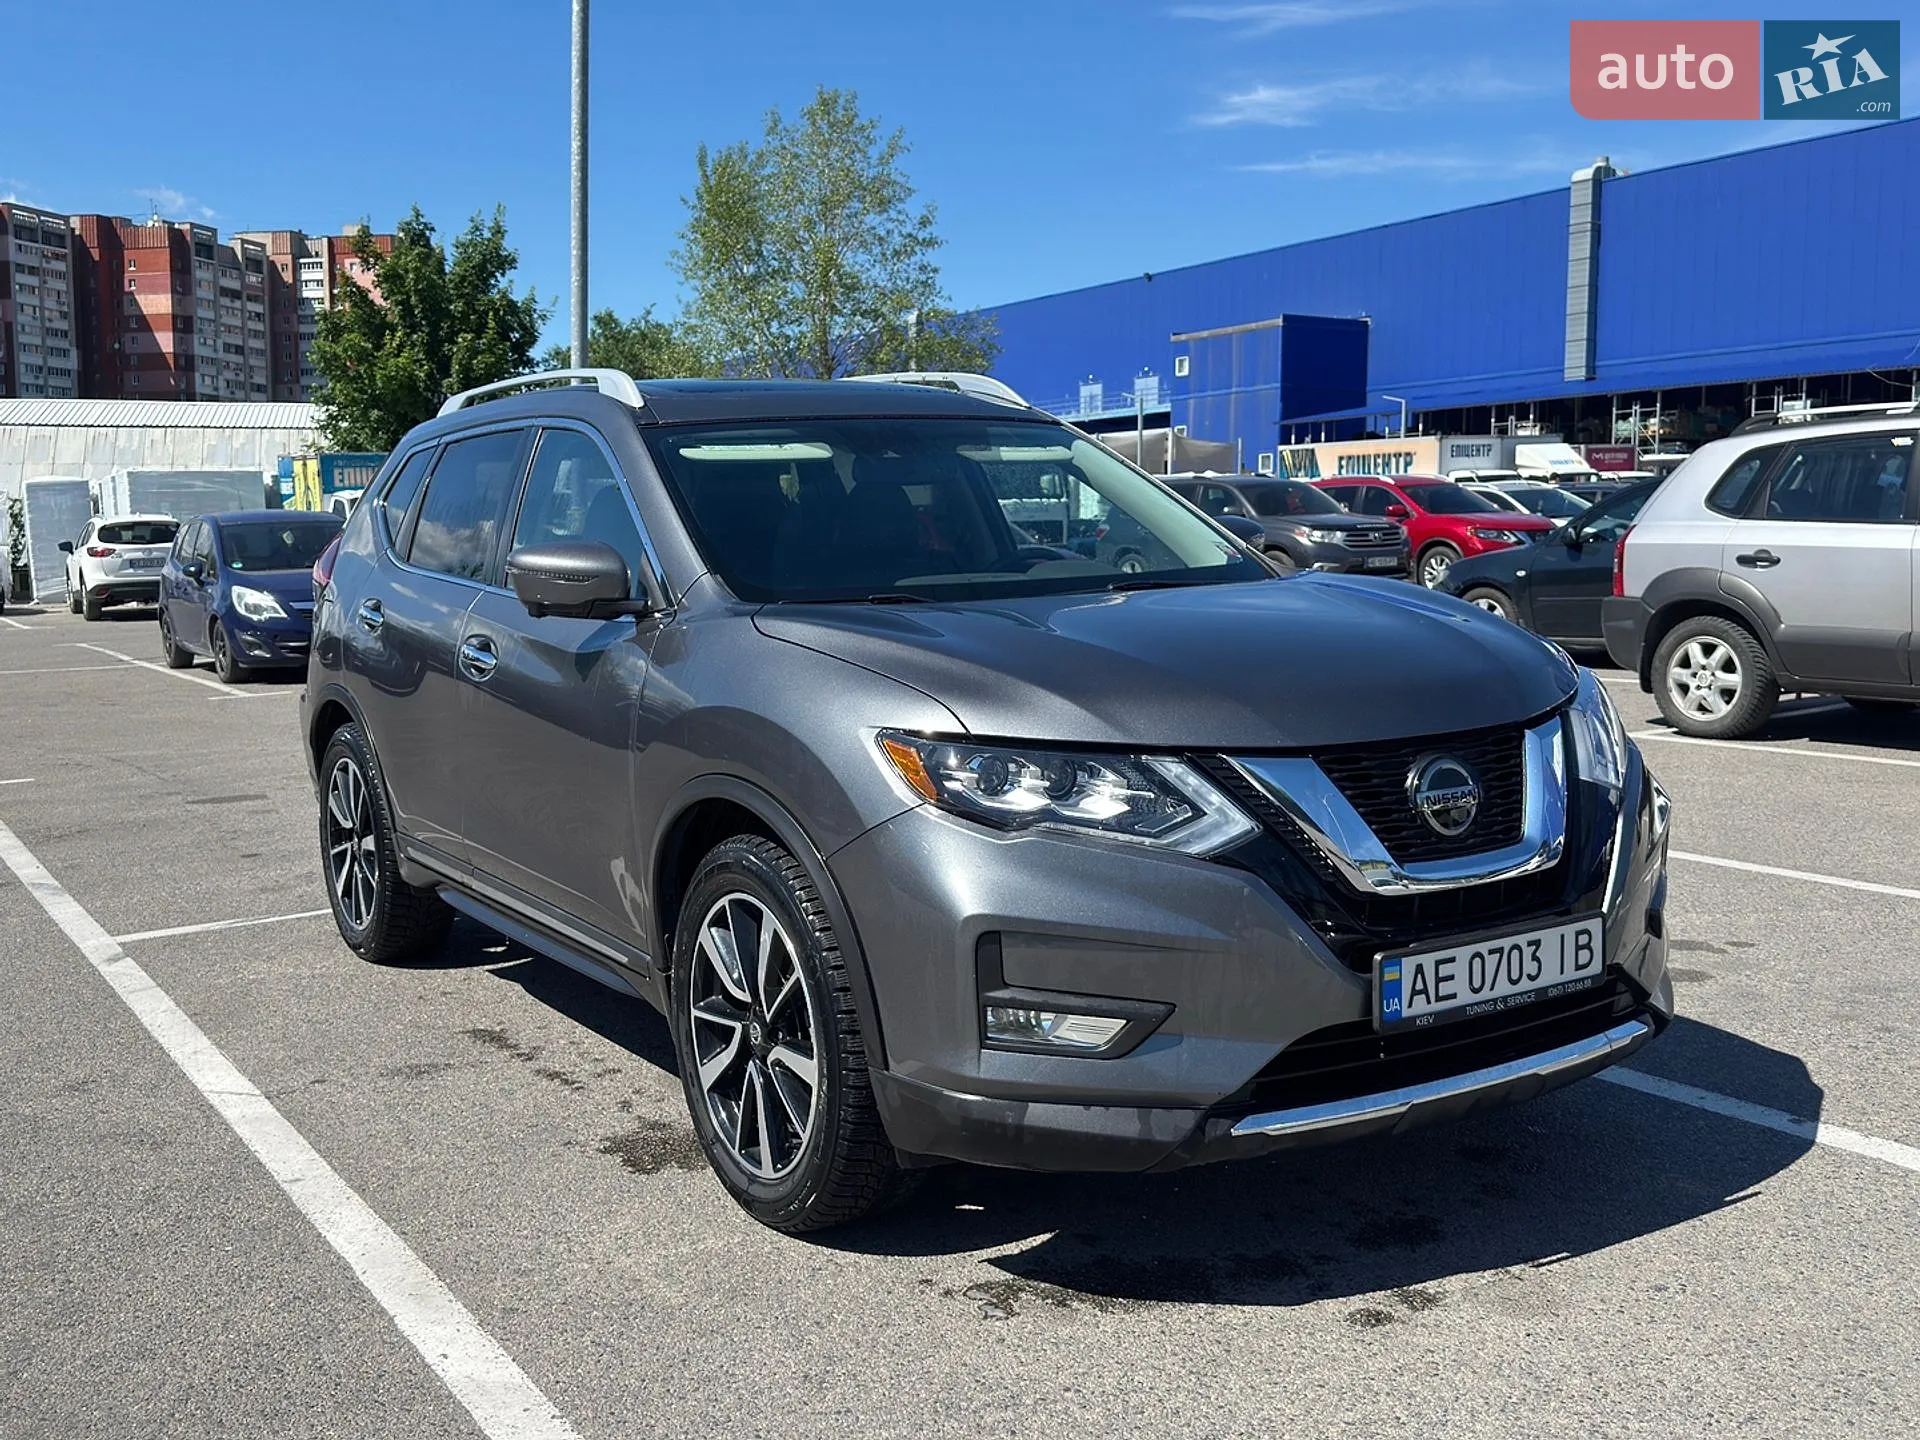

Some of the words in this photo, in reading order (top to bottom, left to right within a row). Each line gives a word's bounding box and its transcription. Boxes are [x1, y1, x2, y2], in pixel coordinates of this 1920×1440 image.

[1425, 787, 1477, 807] NISSAN
[1384, 998, 1401, 1012] UA
[1407, 956, 1458, 1009] AE
[1468, 938, 1543, 994] 0703
[1559, 927, 1595, 975] IB
[1415, 1014, 1435, 1026] KIEV
[1465, 1001, 1495, 1016] TUNING
[1507, 992, 1536, 1007] SERVICE
